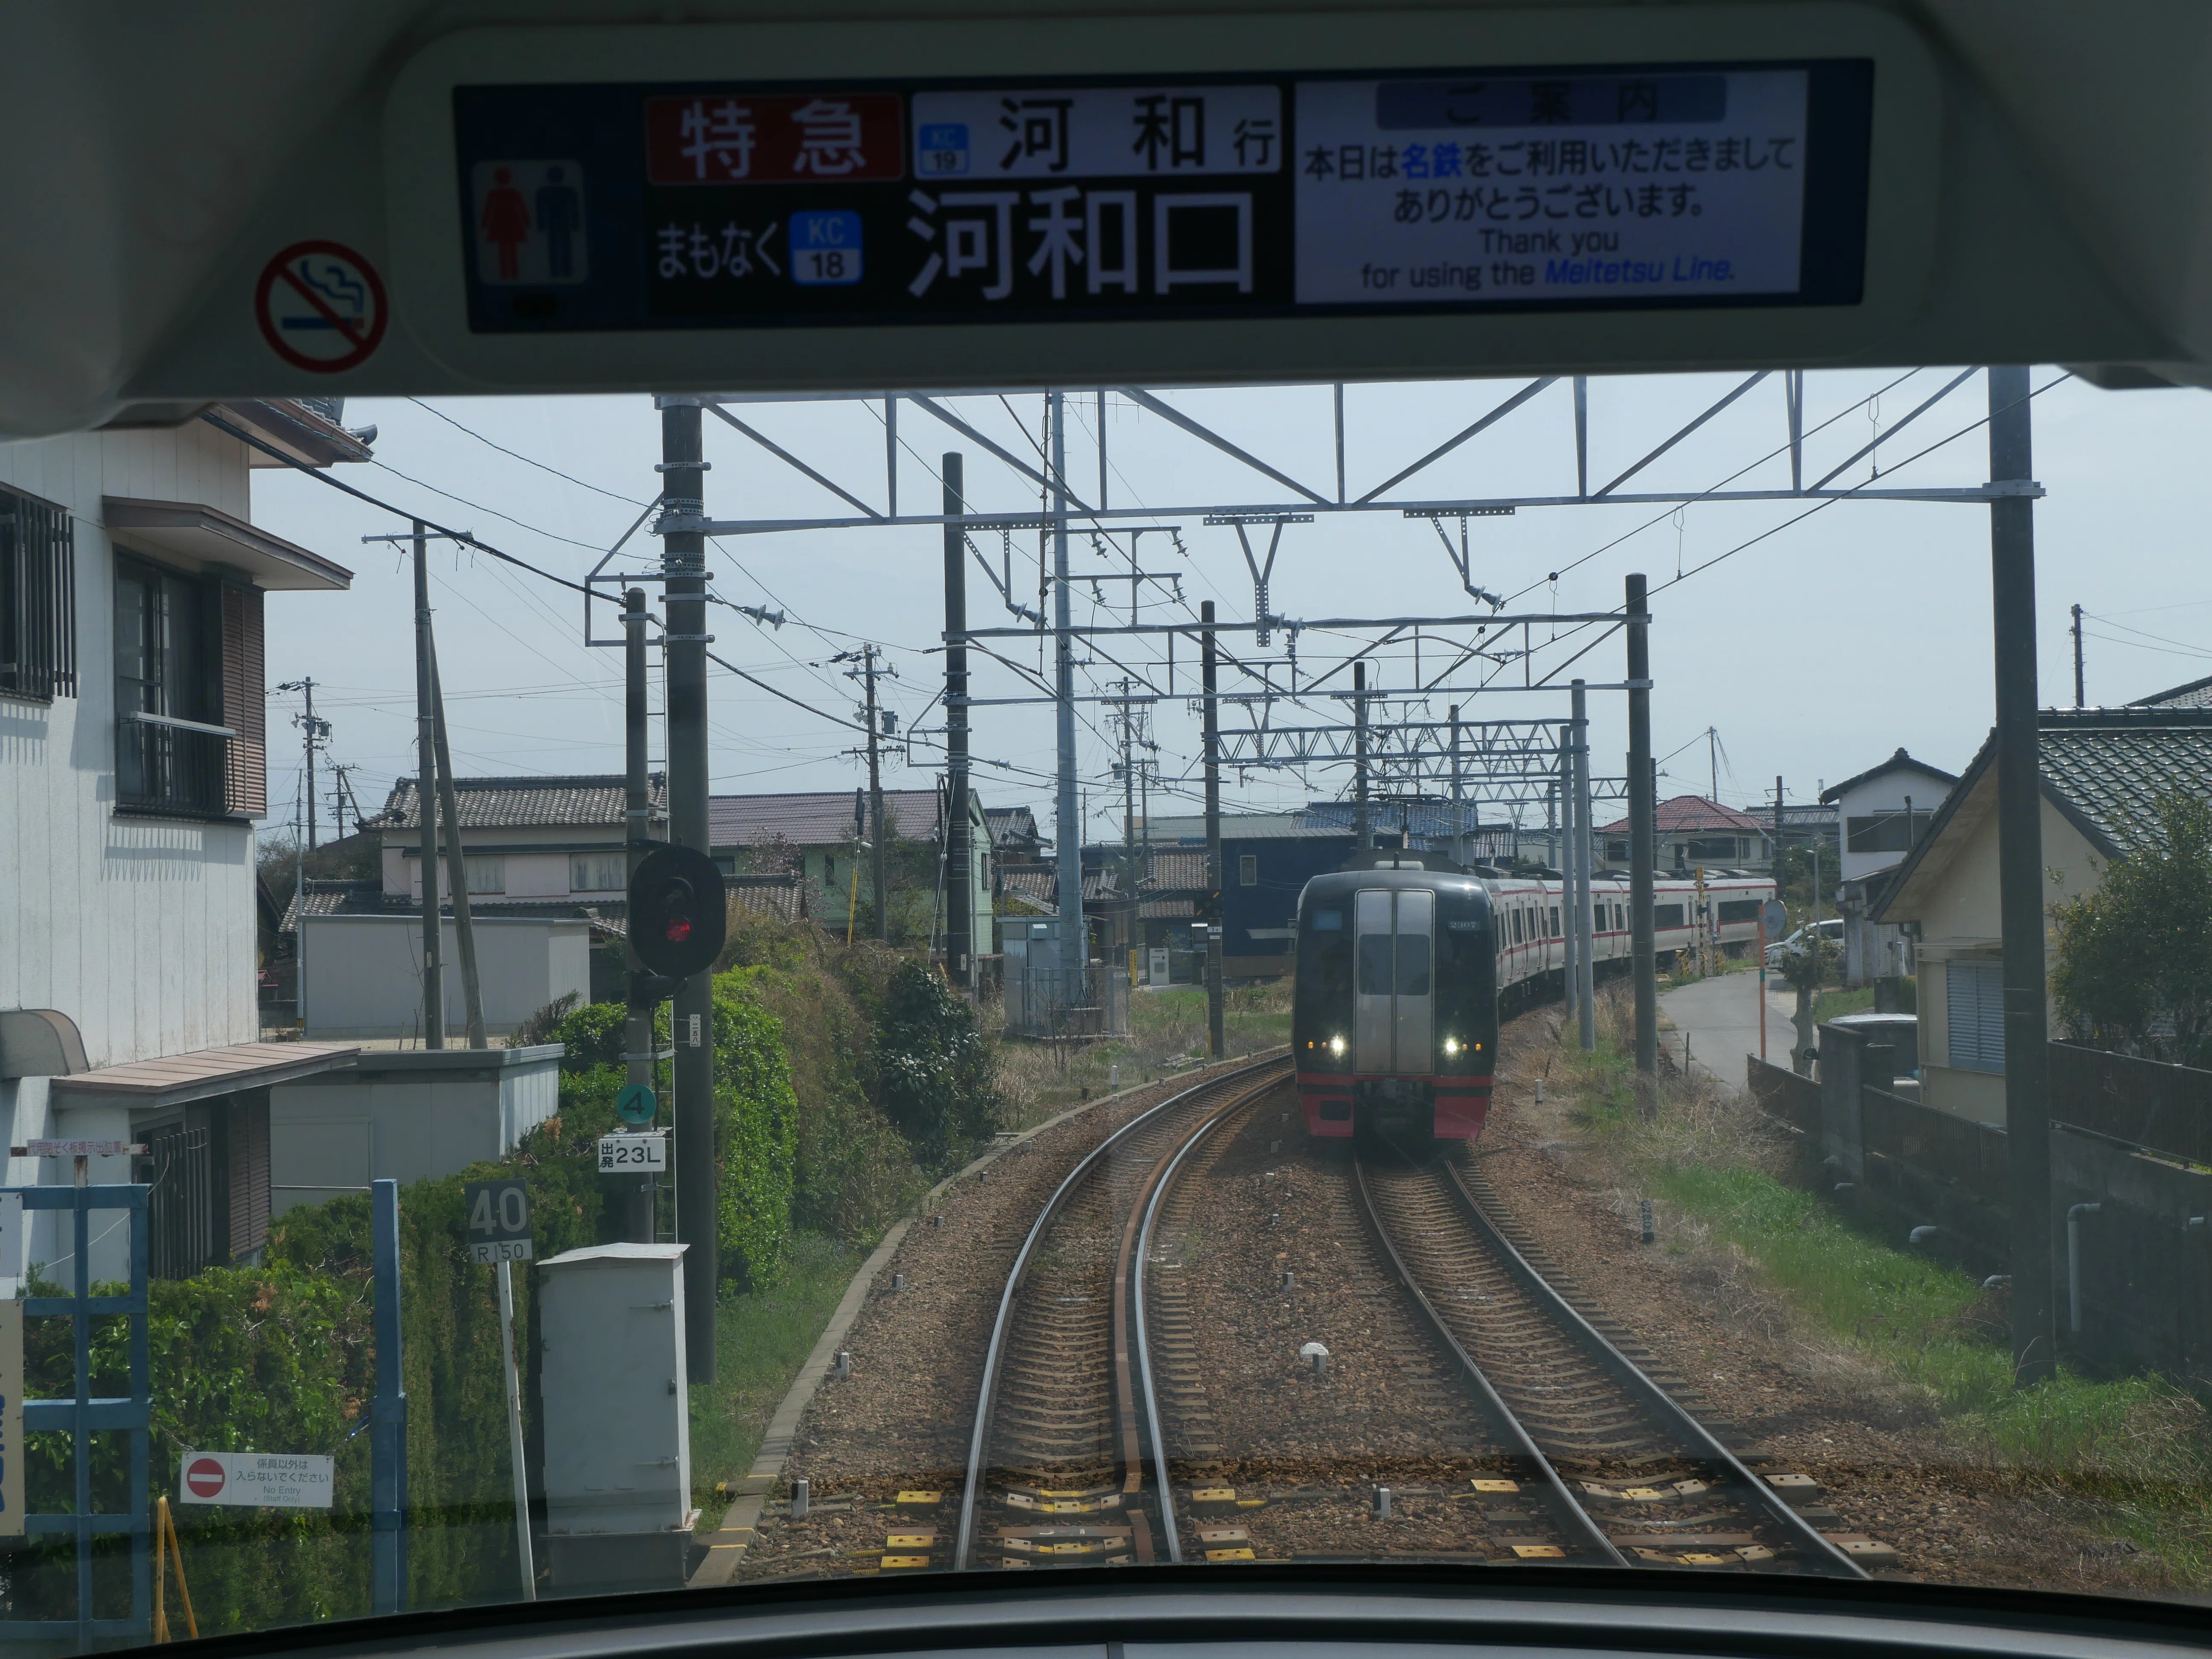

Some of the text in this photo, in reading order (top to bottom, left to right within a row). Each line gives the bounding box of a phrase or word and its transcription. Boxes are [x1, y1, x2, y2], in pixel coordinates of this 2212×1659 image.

[1446, 80, 1657, 125] ご案内
[681, 100, 866, 179] 特急
[933, 151, 956, 170] 19
[1394, 182, 1704, 223] ありがとうございます。
[808, 218, 844, 244] KC
[907, 185, 1253, 300] 河和口
[1479, 229, 1618, 258] Thank you
[658, 221, 781, 278] まもなく
[811, 254, 844, 279] 18
[1362, 256, 1735, 289] for using the Meitetsu Line.
[623, 1092, 645, 1115] 4
[602, 1143, 661, 1168] 出発 23L
[470, 1187, 527, 1234] 40
[236, 1471, 329, 1482] 入らないでください
[257, 1458, 308, 1470] 係員以外は
[279, 1486, 300, 1496] Entry
